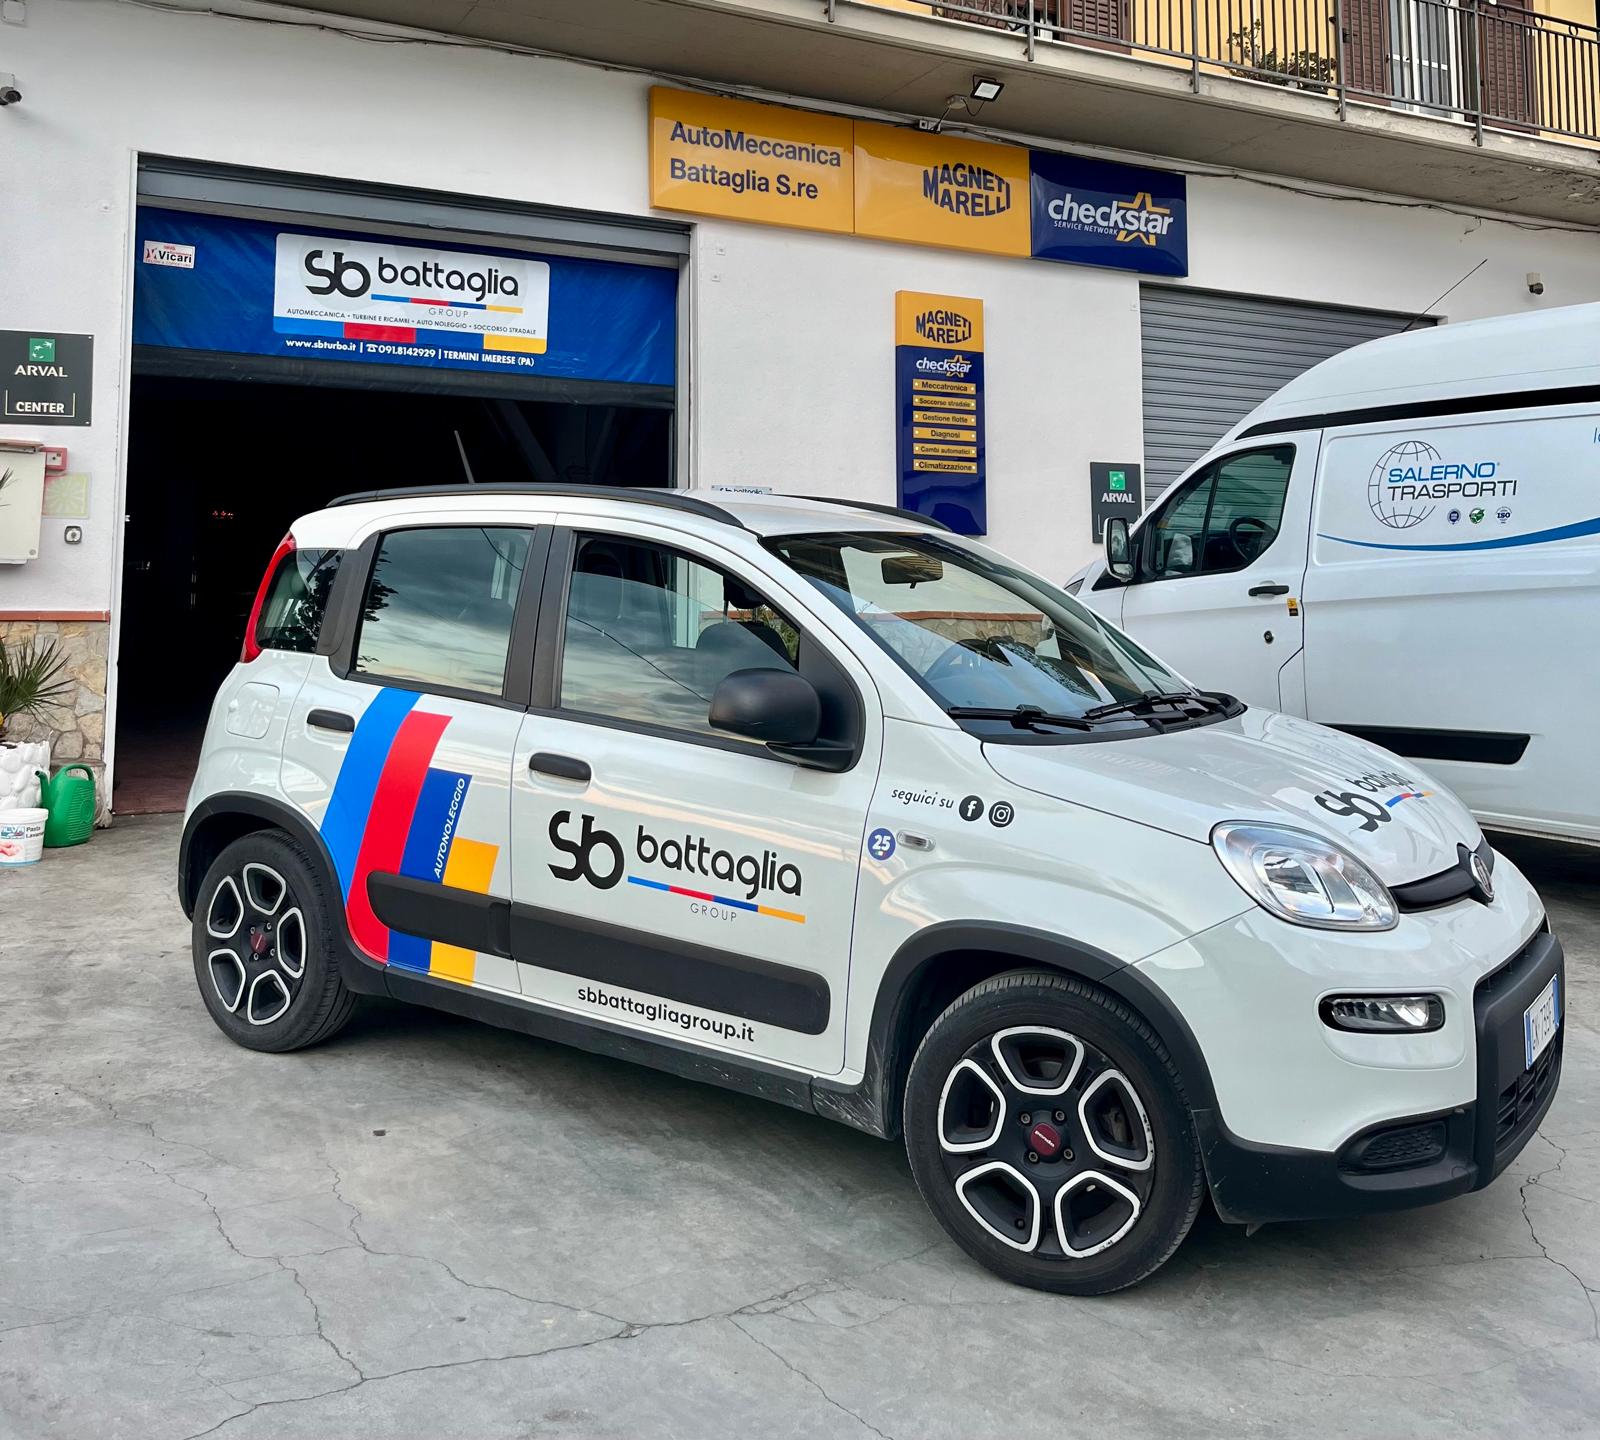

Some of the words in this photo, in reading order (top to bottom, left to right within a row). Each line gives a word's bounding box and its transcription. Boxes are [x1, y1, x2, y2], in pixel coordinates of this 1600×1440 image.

[670, 121, 841, 167] AutoMeccanica
[670, 157, 769, 193] Battaglia
[776, 174, 819, 199] S.re
[923, 162, 1011, 197] MAGNETI
[923, 184, 1011, 217] MARELLI
[1048, 193, 1173, 235] checkstar
[1053, 220, 1082, 231] SERVICE
[1083, 226, 1118, 236] NETWORK
[158, 250, 192, 263] Vicari
[378, 256, 518, 302] battaglia
[287, 308, 346, 319] AUTOMECCANICA
[352, 313, 377, 321] TURBINE
[383, 316, 410, 324] RICAMBI
[434, 320, 467, 329] NOLEGGIO
[473, 324, 508, 333] SOCCORSO
[508, 327, 536, 335] STRADALE
[428, 307, 469, 318] GROUP
[916, 309, 971, 330] MAGNETI
[916, 323, 971, 344] MARELLI
[285, 339, 357, 352] www.sbturbo.it
[443, 350, 480, 362] TERMINI
[481, 354, 516, 365] IMERESE
[517, 357, 535, 367] (PA)
[14, 365, 68, 378] ARVAL
[916, 357, 972, 373] checkstar
[921, 381, 968, 392] Meccatronica
[16, 402, 65, 414] CENTER
[922, 414, 950, 422] Gestione
[930, 430, 960, 439] Diagnosi
[918, 461, 972, 471] Climatizzazione
[1388, 462, 1496, 483] SALERNO
[1101, 493, 1135, 503] ARVAL
[1387, 480, 1518, 501] TRASPORTI
[891, 788, 938, 806] seguici
[939, 798, 955, 809] su
[433, 777, 465, 879] AUTONOLEGGIO
[872, 834, 891, 851] 25
[636, 825, 802, 900] battaglia
[690, 902, 737, 922] GROUP
[578, 986, 755, 1042] sbbattagliagroup.it
